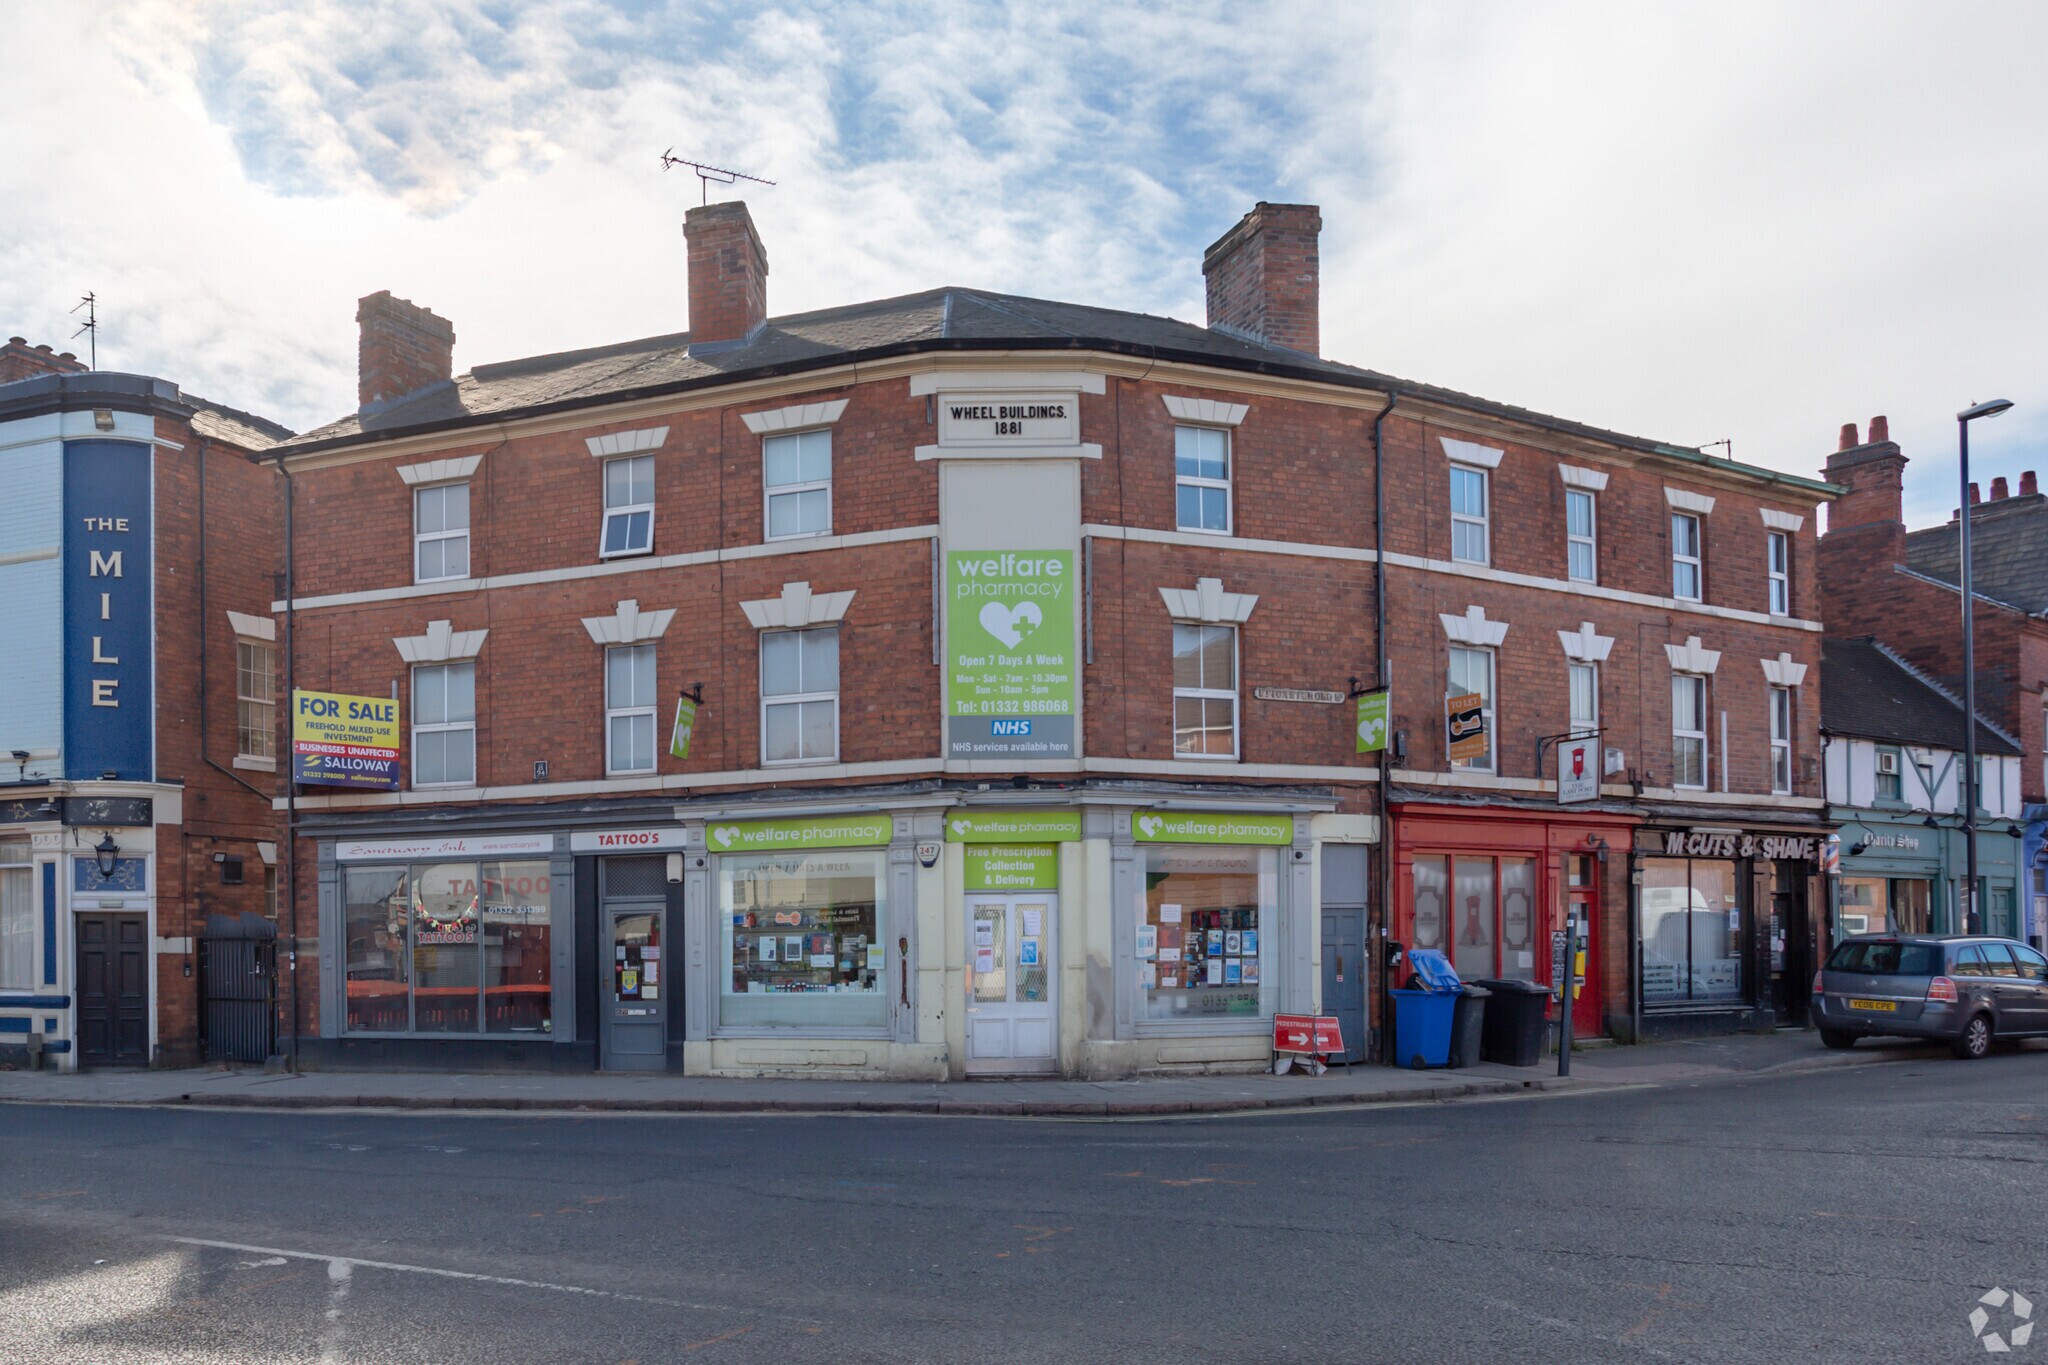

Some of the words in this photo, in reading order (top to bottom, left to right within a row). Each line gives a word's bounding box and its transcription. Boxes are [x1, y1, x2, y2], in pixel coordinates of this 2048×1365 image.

[950, 406, 996, 420] WHEEL
[995, 421, 1022, 435] 1881
[83, 517, 129, 532] THE
[957, 553, 1063, 577] welfare
[957, 579, 1063, 600] pharmacy
[89, 550, 123, 708] MILE
[959, 655, 985, 668] Open
[988, 655, 995, 665] 7
[998, 654, 1023, 668] Days
[1026, 654, 1033, 665] A
[1036, 654, 1064, 665] Week
[956, 674, 974, 683] Mon
[983, 674, 996, 683] Sat
[1006, 674, 1023, 683] 7am
[1032, 673, 1068, 684] 10.30pm
[975, 685, 991, 694] Sun
[1000, 685, 1022, 694] 10am
[1031, 685, 1049, 695] 5pm
[1314, 692, 1332, 701] OLD
[299, 697, 340, 718] FOR
[348, 701, 394, 722] SALE
[956, 700, 977, 713] Tel:
[981, 700, 1019, 713] 01332
[1023, 699, 1069, 713] 986068
[1450, 700, 1462, 710] TO
[1463, 697, 1478, 708] LET
[305, 721, 346, 732] FREEHOLD
[348, 725, 391, 735] MIXED-USE
[993, 720, 1030, 735] NHS
[323, 732, 374, 743] INVESTMENT
[299, 743, 346, 754] BUSINESSES
[347, 747, 395, 758] UNAFFECTED
[952, 742, 971, 752] NHS
[973, 742, 1009, 751] services
[1010, 741, 1048, 751] available
[1050, 741, 1069, 751] here
[324, 757, 391, 772] SALLOWAY
[350, 774, 391, 784] salloway.com
[743, 827, 800, 842] welfare
[802, 825, 882, 842] pharmacy
[974, 822, 1017, 832] welfare
[1019, 822, 1078, 833] pharmacy
[1165, 820, 1216, 834] welfare
[1218, 822, 1285, 839] pharmacy
[598, 831, 659, 846] TATTOO'S
[1896, 833, 1919, 850] Shop
[348, 845, 431, 858] Sanctuary
[438, 840, 466, 853] Ink
[920, 846, 934, 855] 247
[967, 847, 989, 857] Free
[992, 846, 1052, 858] Prescription
[1687, 833, 1736, 857] CUTS
[1740, 834, 1754, 857] &
[1762, 835, 1815, 859] SHAVE
[984, 861, 1035, 871] Collection
[985, 874, 992, 885] &
[995, 874, 1035, 886] Delivery
[488, 906, 513, 914] 01332
[516, 905, 546, 914] 331399
[1276, 1020, 1313, 1028] PEDESTRIANS
